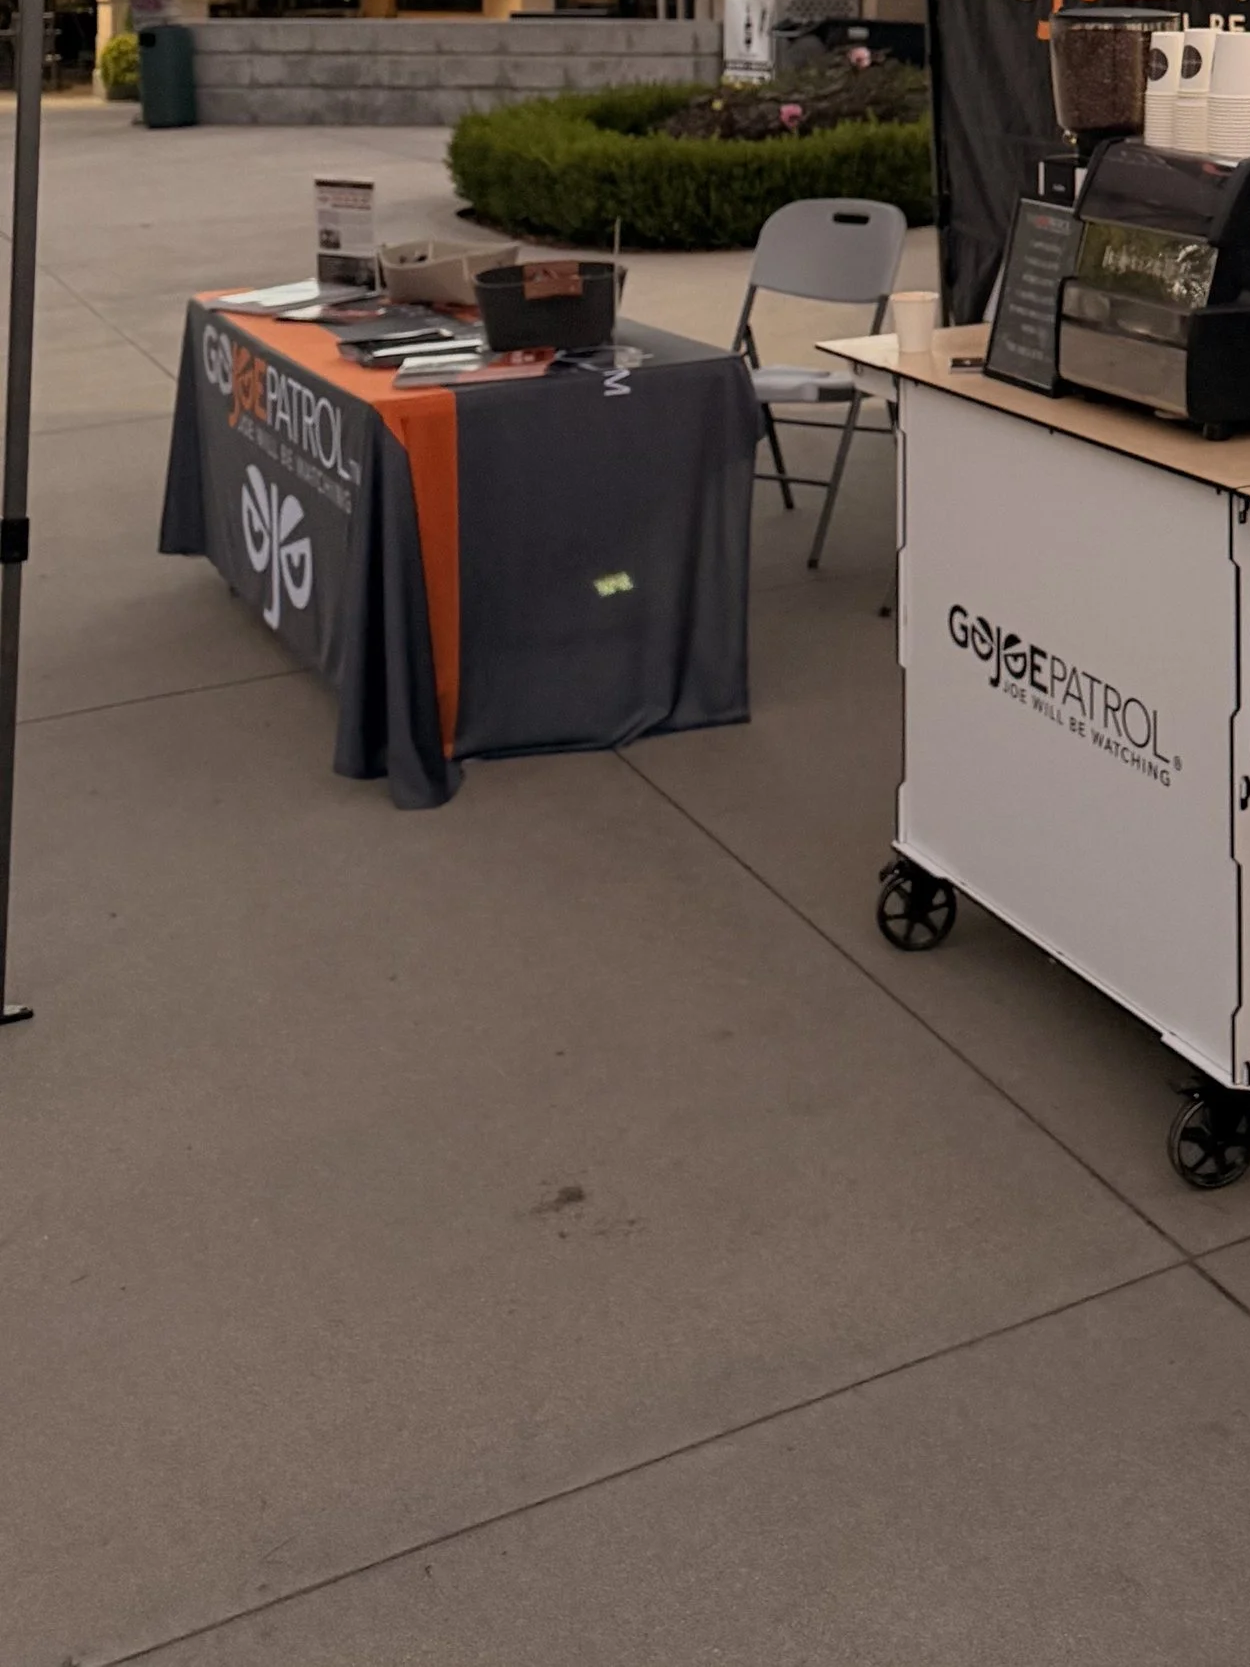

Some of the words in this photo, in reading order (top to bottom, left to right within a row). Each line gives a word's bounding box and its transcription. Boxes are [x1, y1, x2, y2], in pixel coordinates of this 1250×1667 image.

[1003, 681, 1027, 704] JOE
[1032, 695, 1065, 726] WILL
[1069, 717, 1087, 738] BE
[1091, 729, 1172, 787] WATCHING
